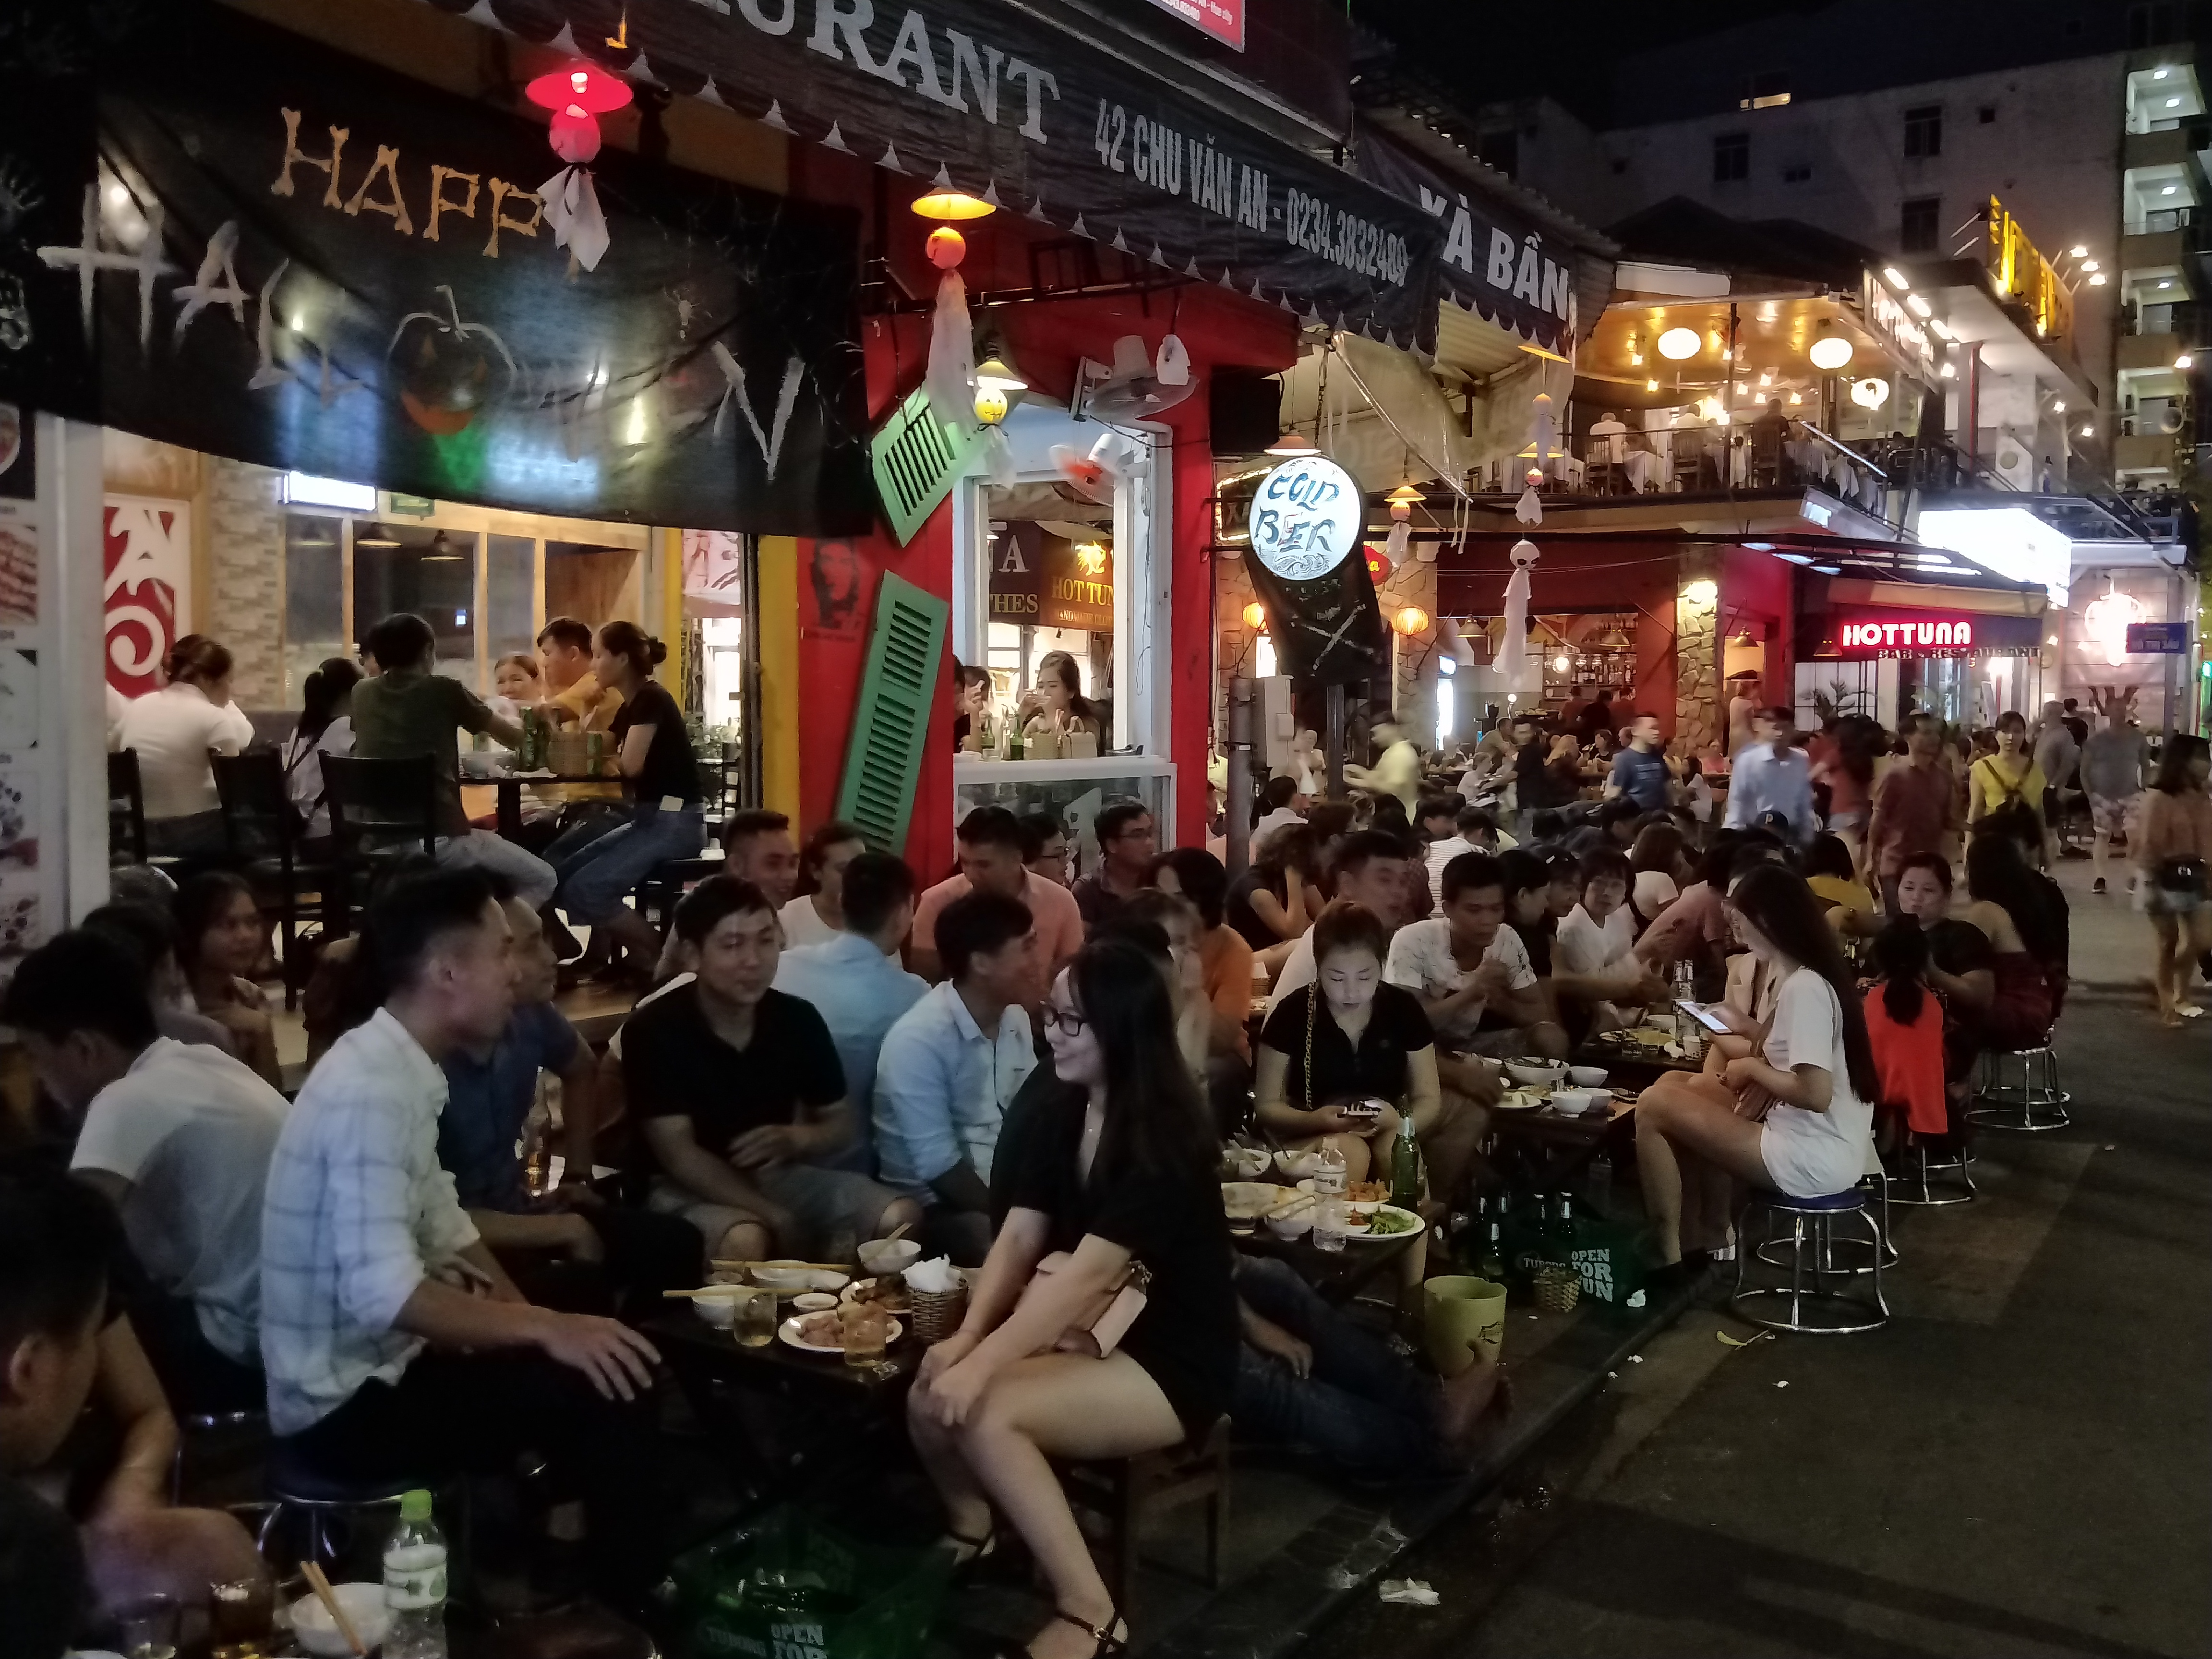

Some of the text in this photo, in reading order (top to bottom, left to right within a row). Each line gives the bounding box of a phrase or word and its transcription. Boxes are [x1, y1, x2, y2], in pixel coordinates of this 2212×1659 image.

[696, 0, 1060, 145] URANT
[272, 107, 579, 286] HAPP
[1095, 97, 1126, 173] 42
[1133, 114, 1182, 195] CHU
[1189, 132, 1233, 218] VĂN
[1238, 164, 1268, 233] AN
[1487, 230, 1569, 322] BẦN
[1267, 472, 1340, 512] COLD
[1052, 577, 1084, 602] HOT
[1571, 1248, 1610, 1262] OPEN
[1581, 1277, 1613, 1302] UN
